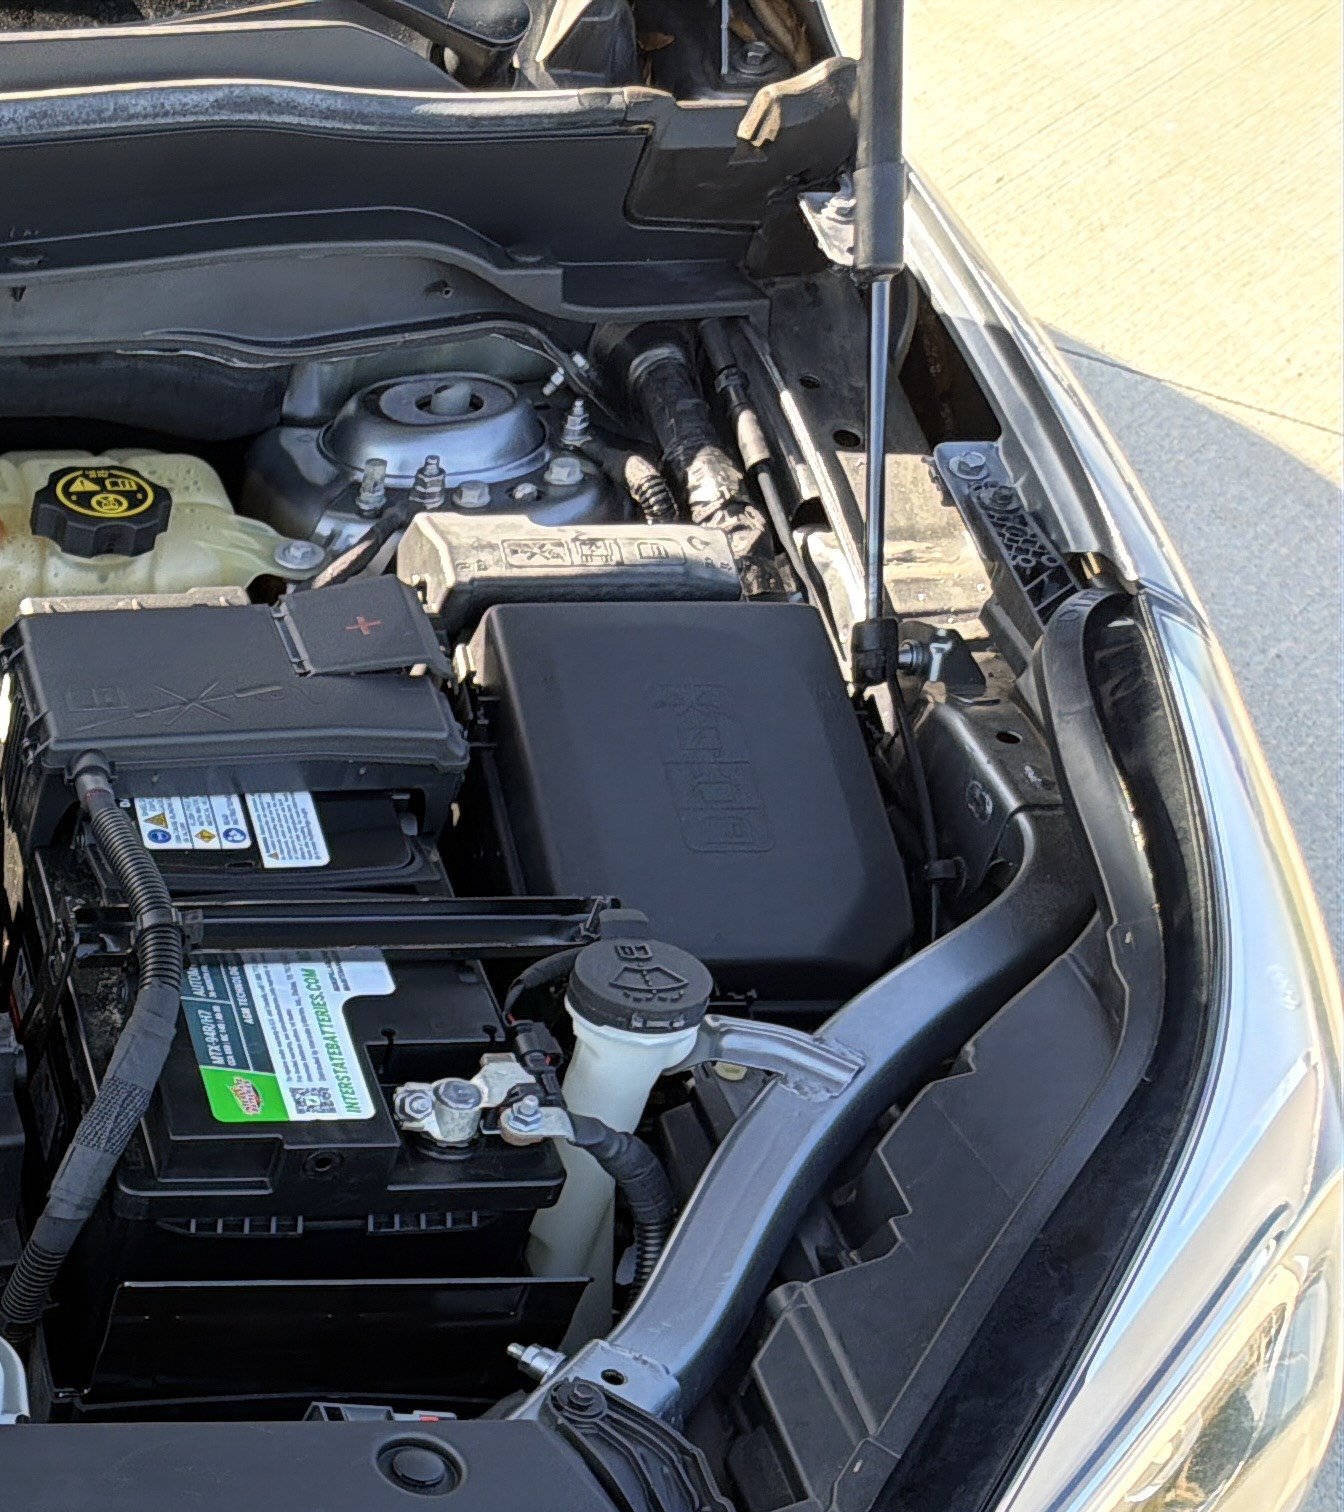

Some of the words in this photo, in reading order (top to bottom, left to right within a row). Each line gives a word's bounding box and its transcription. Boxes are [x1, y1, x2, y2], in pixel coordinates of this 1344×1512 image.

[197, 1008, 225, 1065] MTX-94R/H7
[240, 1007, 254, 1025] AGM
[301, 967, 362, 1114] INTERSTATEBATTERIES.COM
